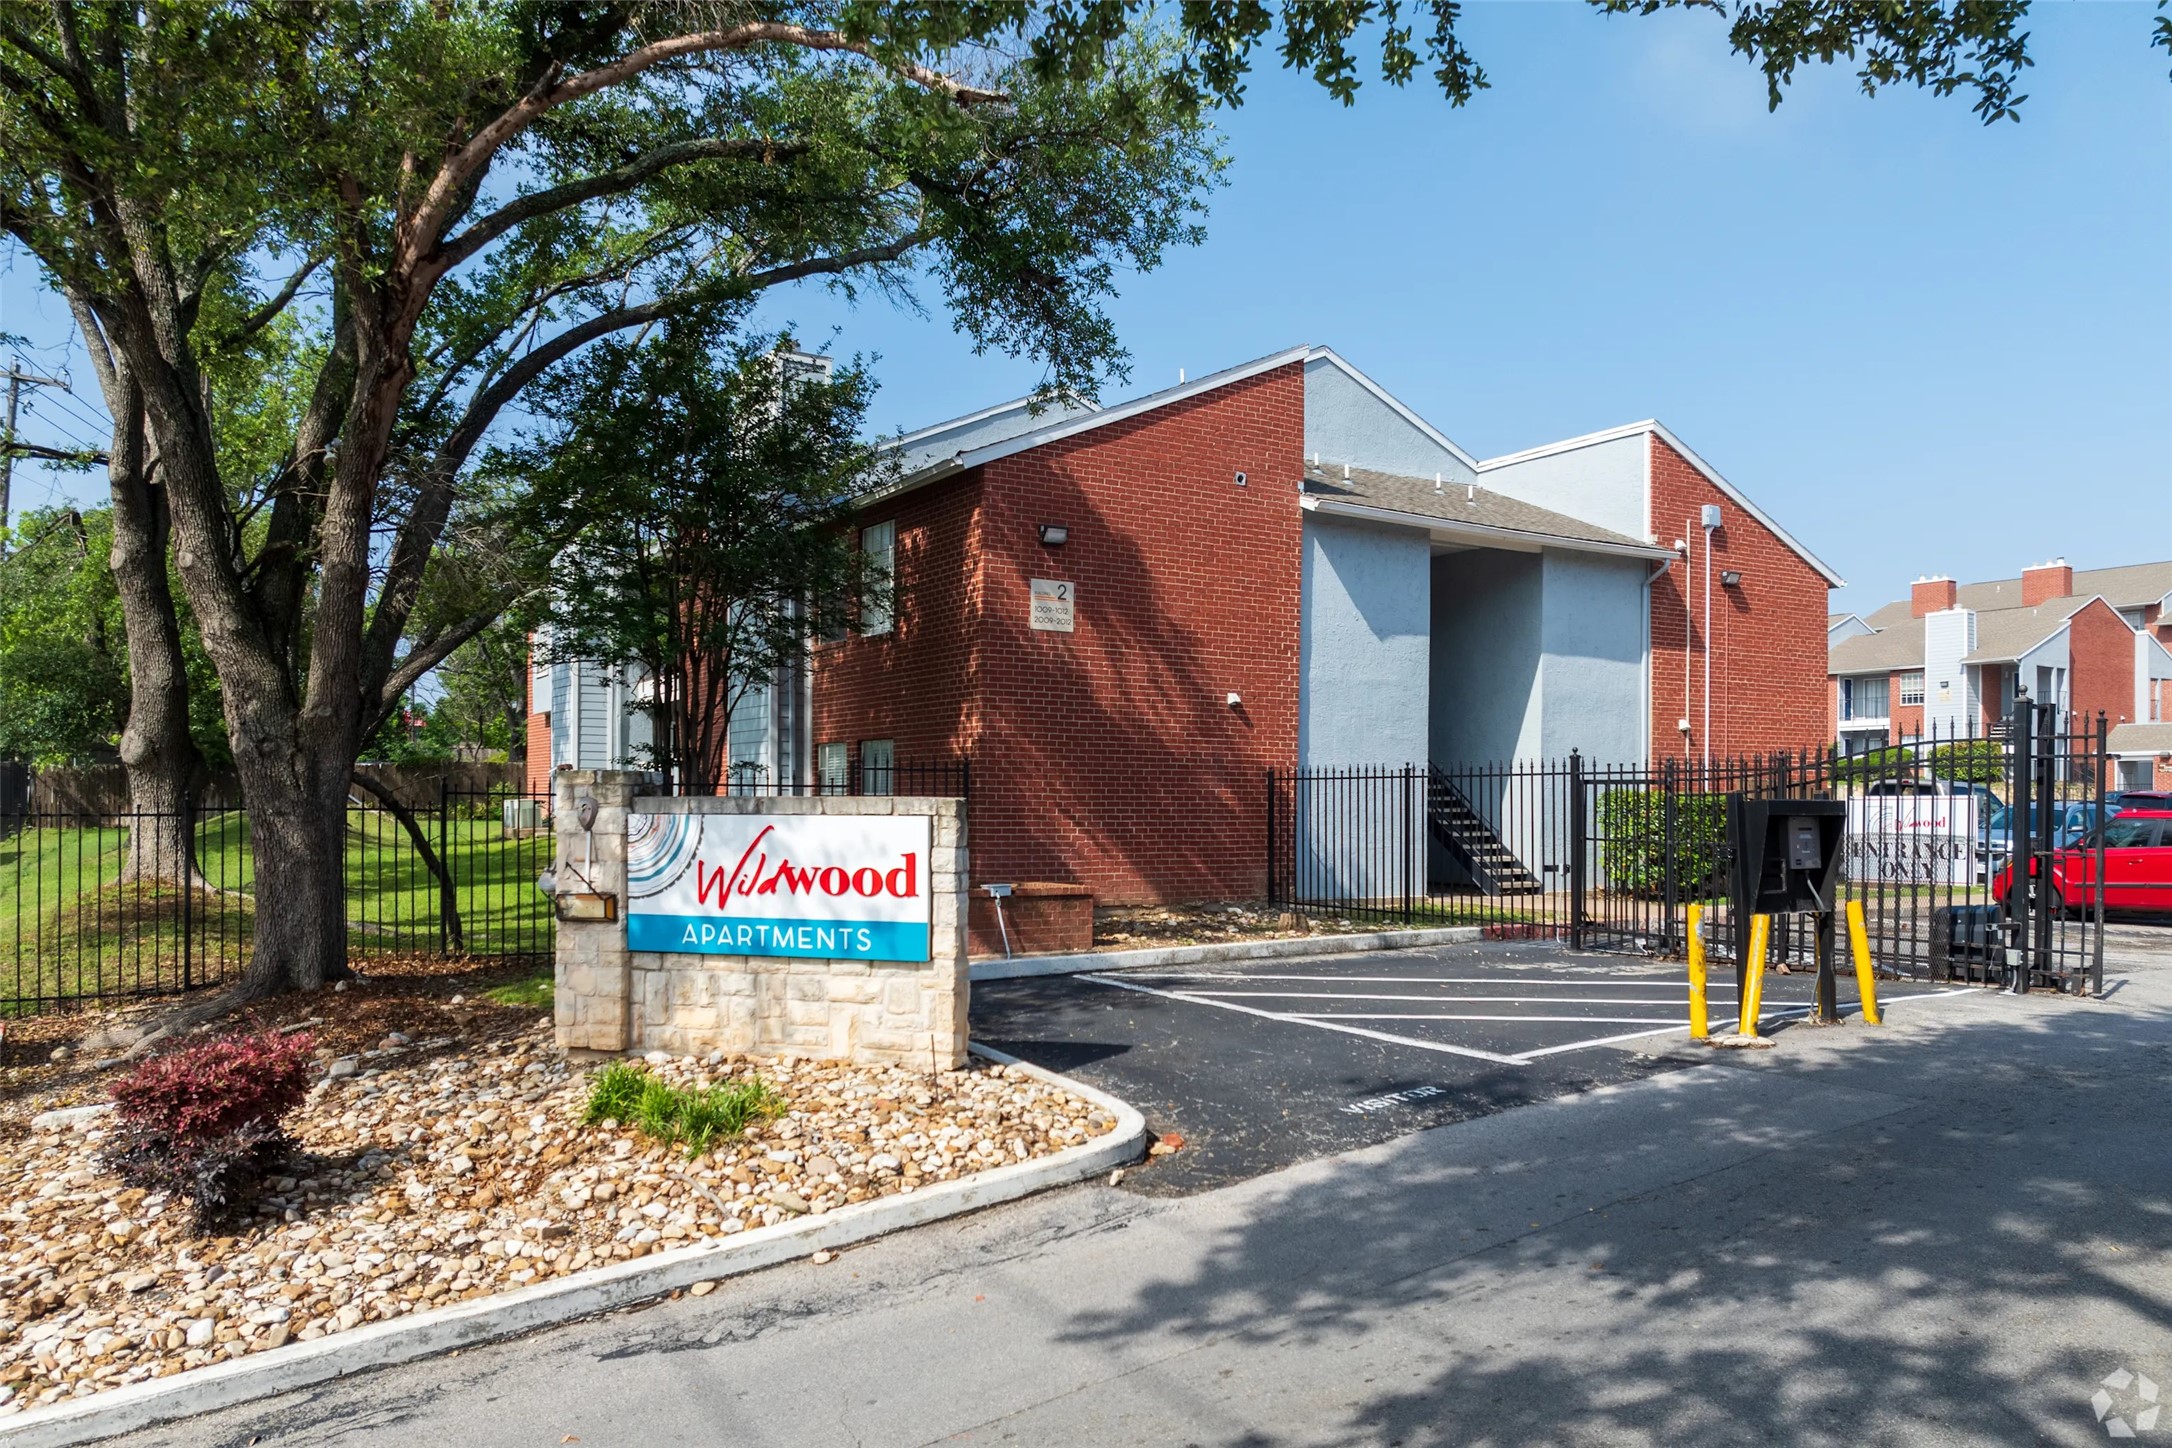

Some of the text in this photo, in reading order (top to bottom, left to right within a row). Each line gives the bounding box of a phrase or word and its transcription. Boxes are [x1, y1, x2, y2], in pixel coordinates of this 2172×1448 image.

[1057, 584, 1067, 601] 2
[1034, 605, 1069, 615] 1009-1012
[1034, 616, 1072, 626] 2009-2012
[697, 824, 920, 910] Wildwood
[1881, 862, 1934, 878] ONY
[682, 923, 872, 952] APARTMENTS
[1339, 1085, 1448, 1115] VISITOR
